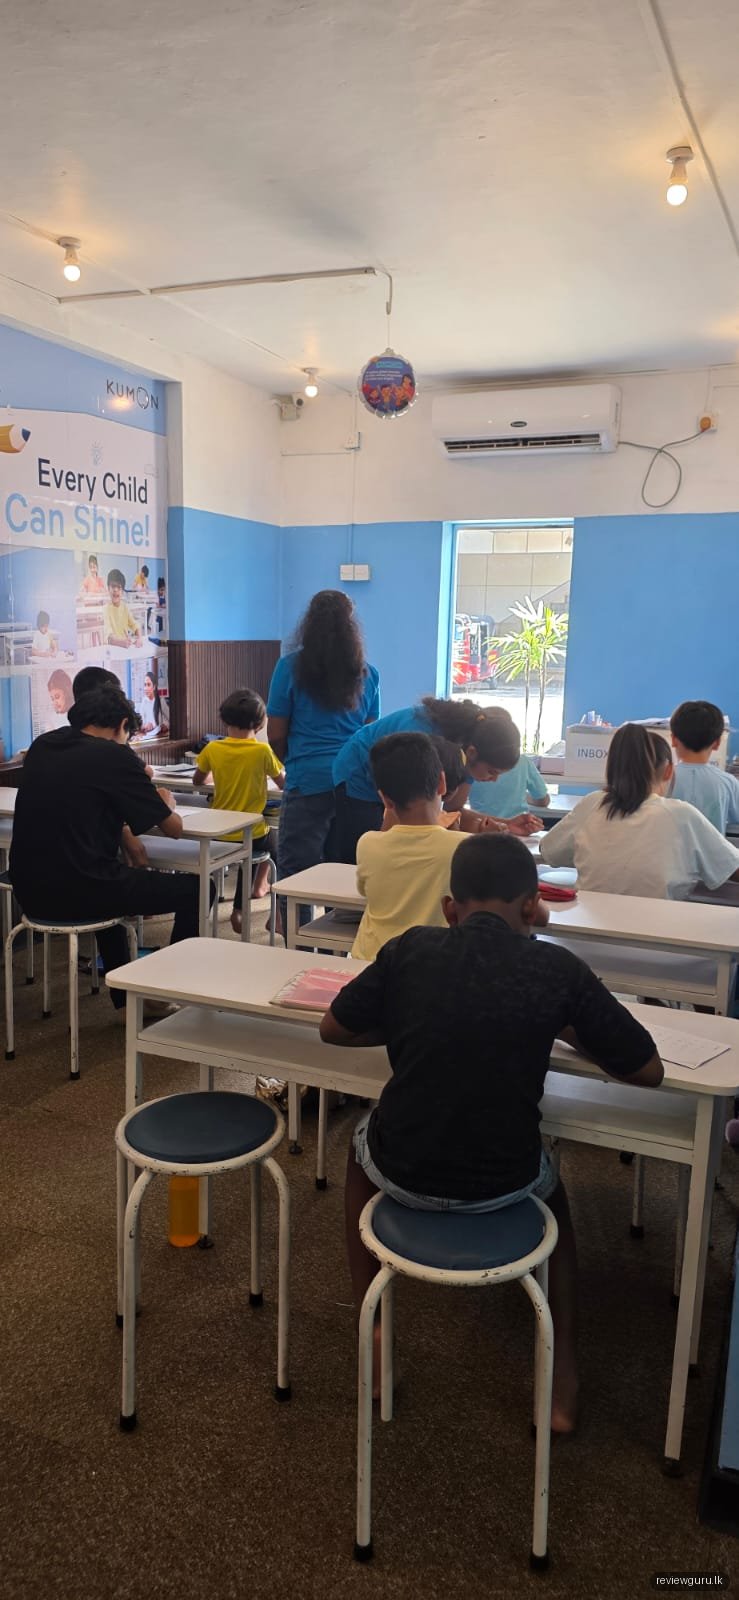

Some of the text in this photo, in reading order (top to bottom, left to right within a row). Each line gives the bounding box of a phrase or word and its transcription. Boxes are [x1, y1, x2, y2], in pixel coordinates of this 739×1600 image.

[106, 379, 159, 410] KUMON
[38, 458, 148, 504] Every Child
[6, 493, 150, 547] Can Shine!
